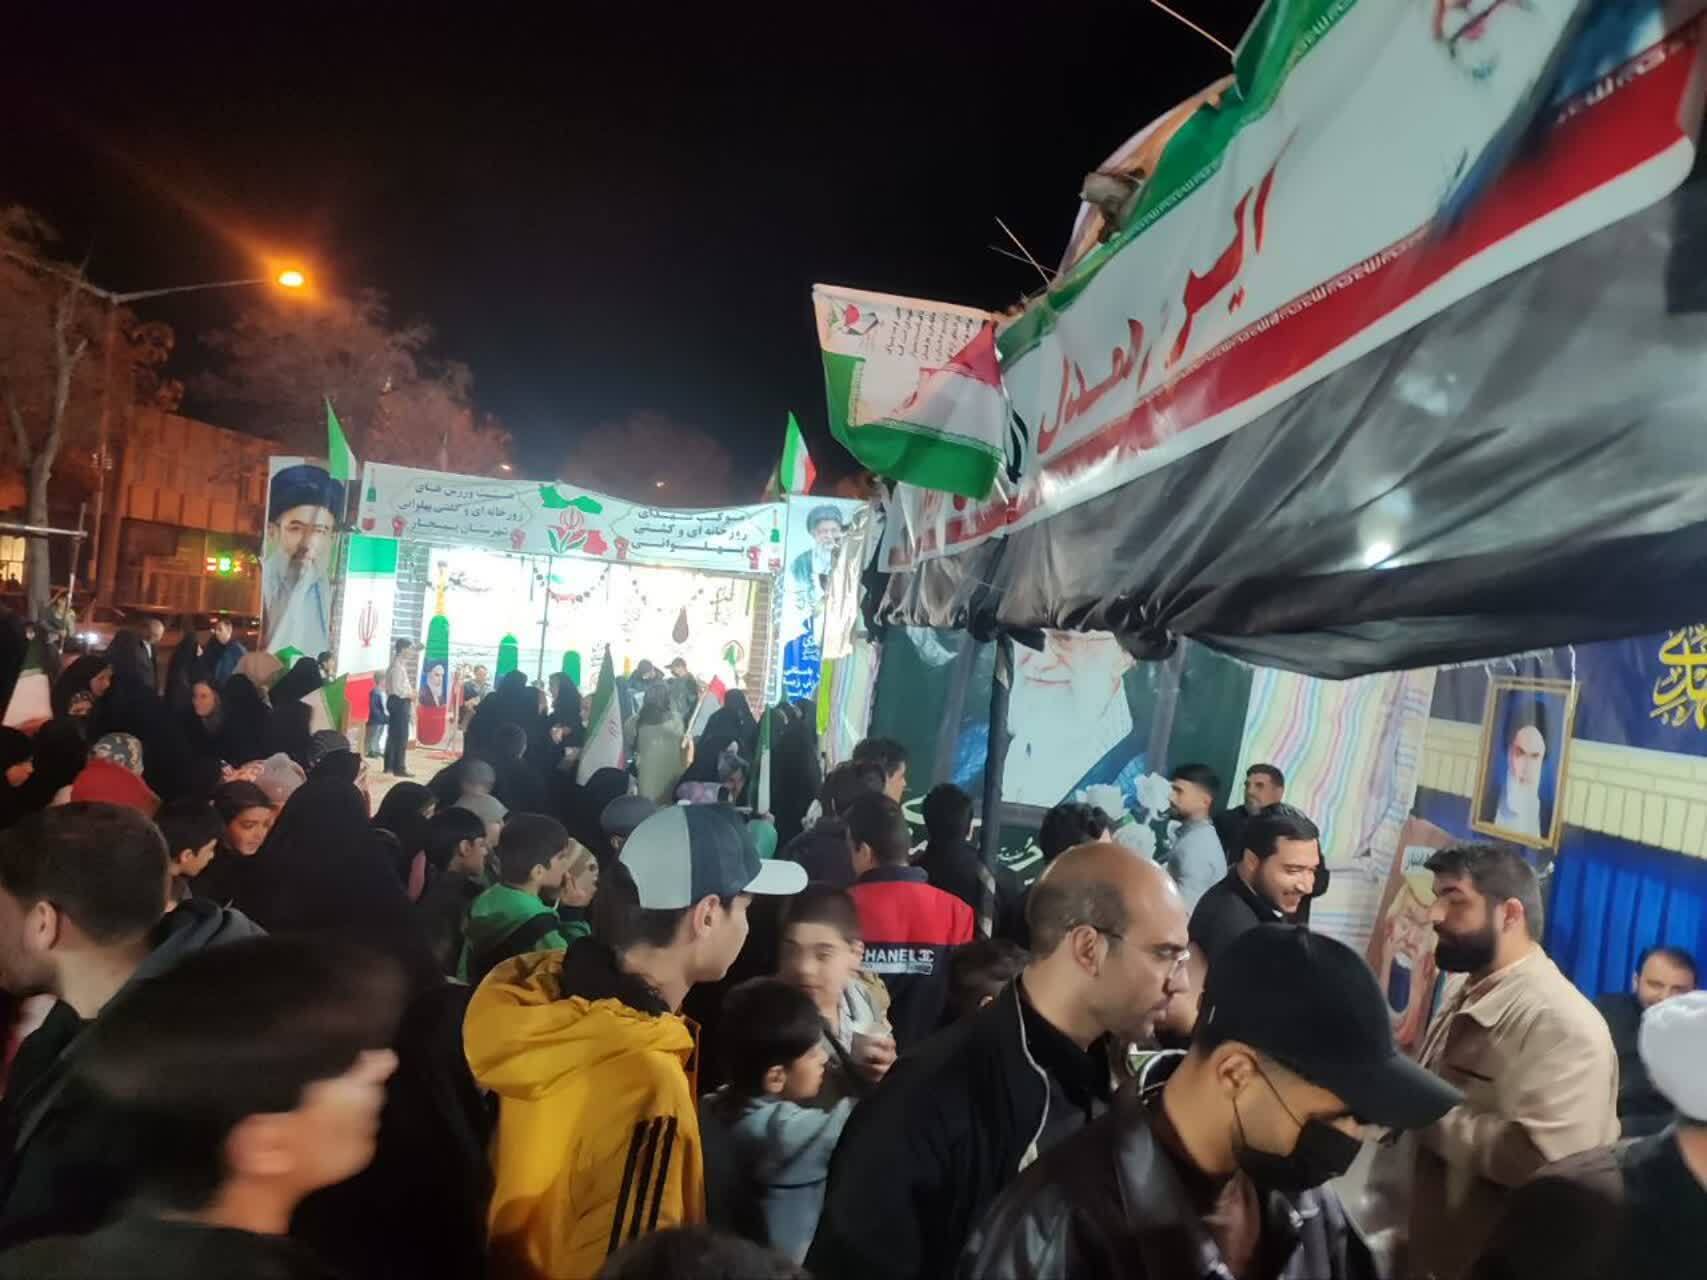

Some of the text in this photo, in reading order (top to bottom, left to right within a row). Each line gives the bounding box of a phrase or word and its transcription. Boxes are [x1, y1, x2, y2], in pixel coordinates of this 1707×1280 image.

[696, 512, 745, 525] موکب
[631, 539, 746, 555] پهلوانی
[862, 947, 915, 963] HANEL
